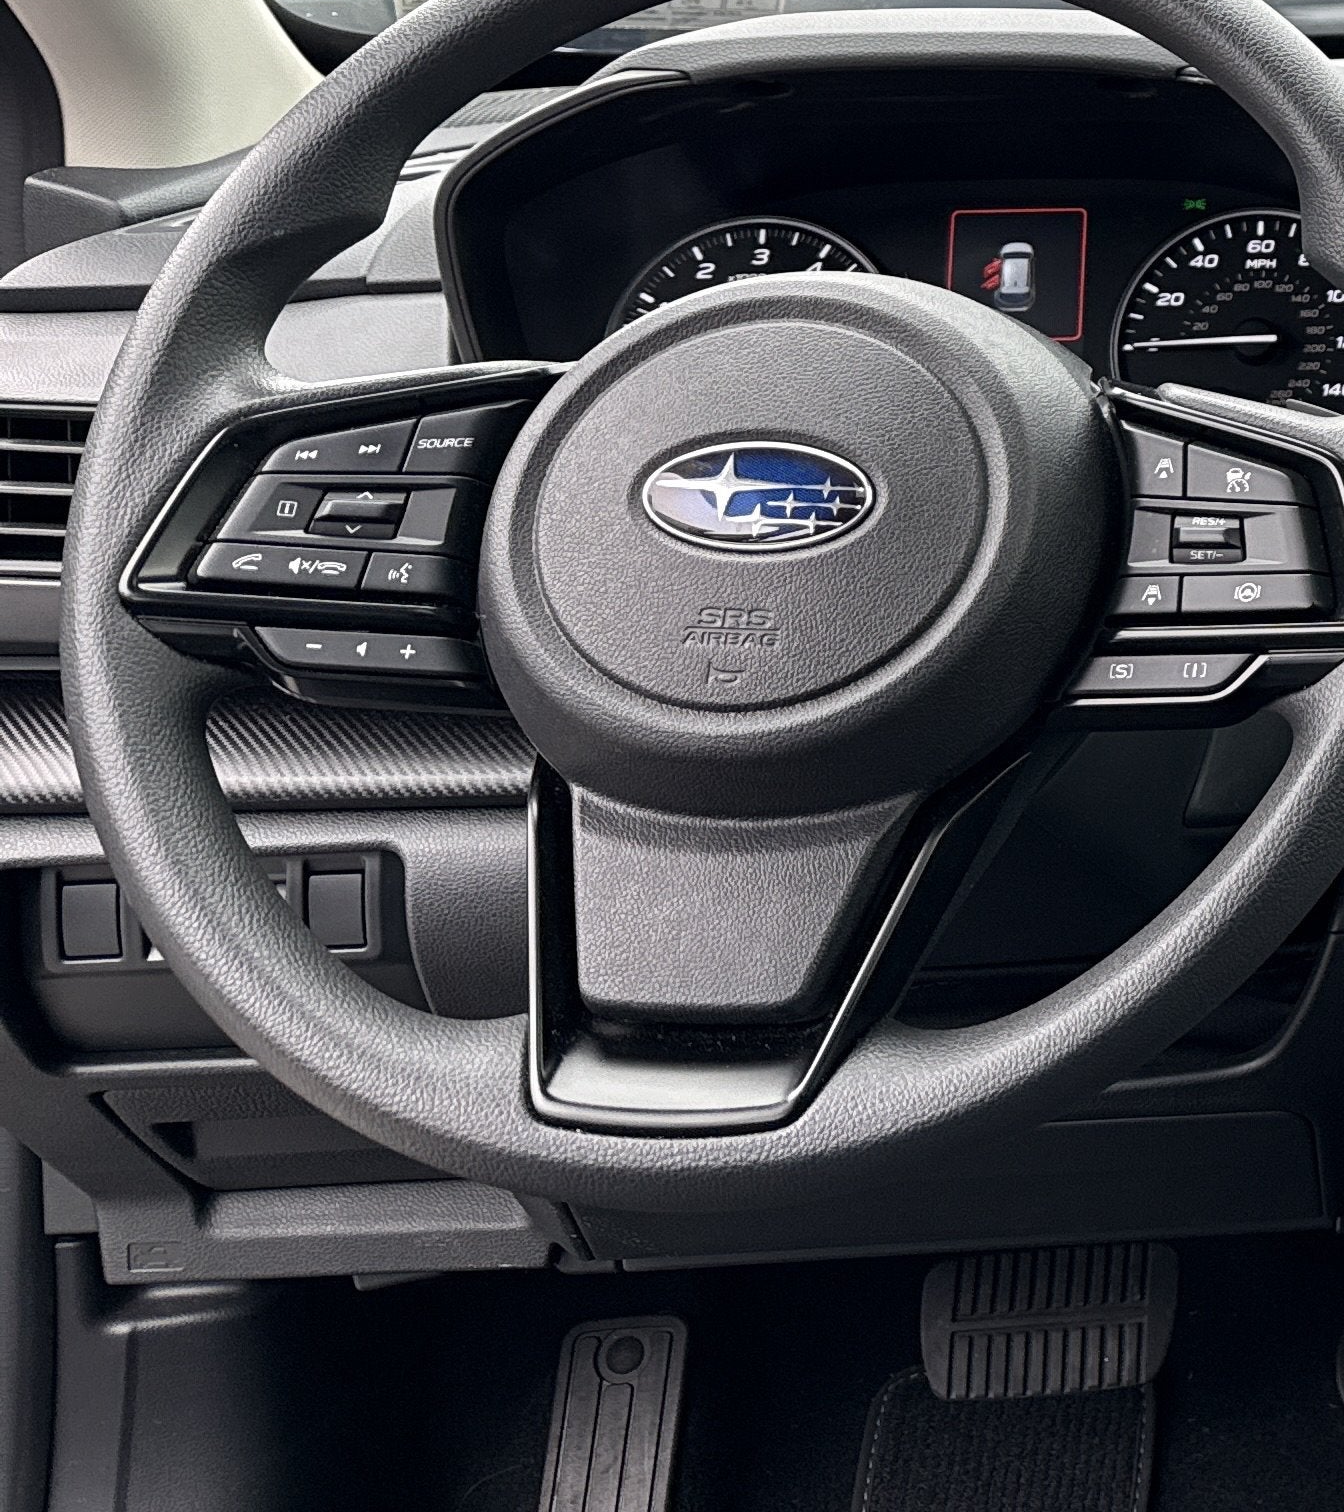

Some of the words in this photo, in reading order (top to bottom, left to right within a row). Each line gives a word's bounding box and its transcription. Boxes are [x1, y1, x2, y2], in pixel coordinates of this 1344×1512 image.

[1246, 240, 1275, 254] 60
[751, 248, 771, 266] 3
[1189, 254, 1219, 268] 40
[1244, 259, 1277, 270] MPH
[695, 262, 716, 280] 2
[1155, 292, 1185, 307] 20
[416, 437, 475, 449] SOURCE
[697, 607, 773, 628] SRS
[681, 631, 780, 647] AIRBAG
